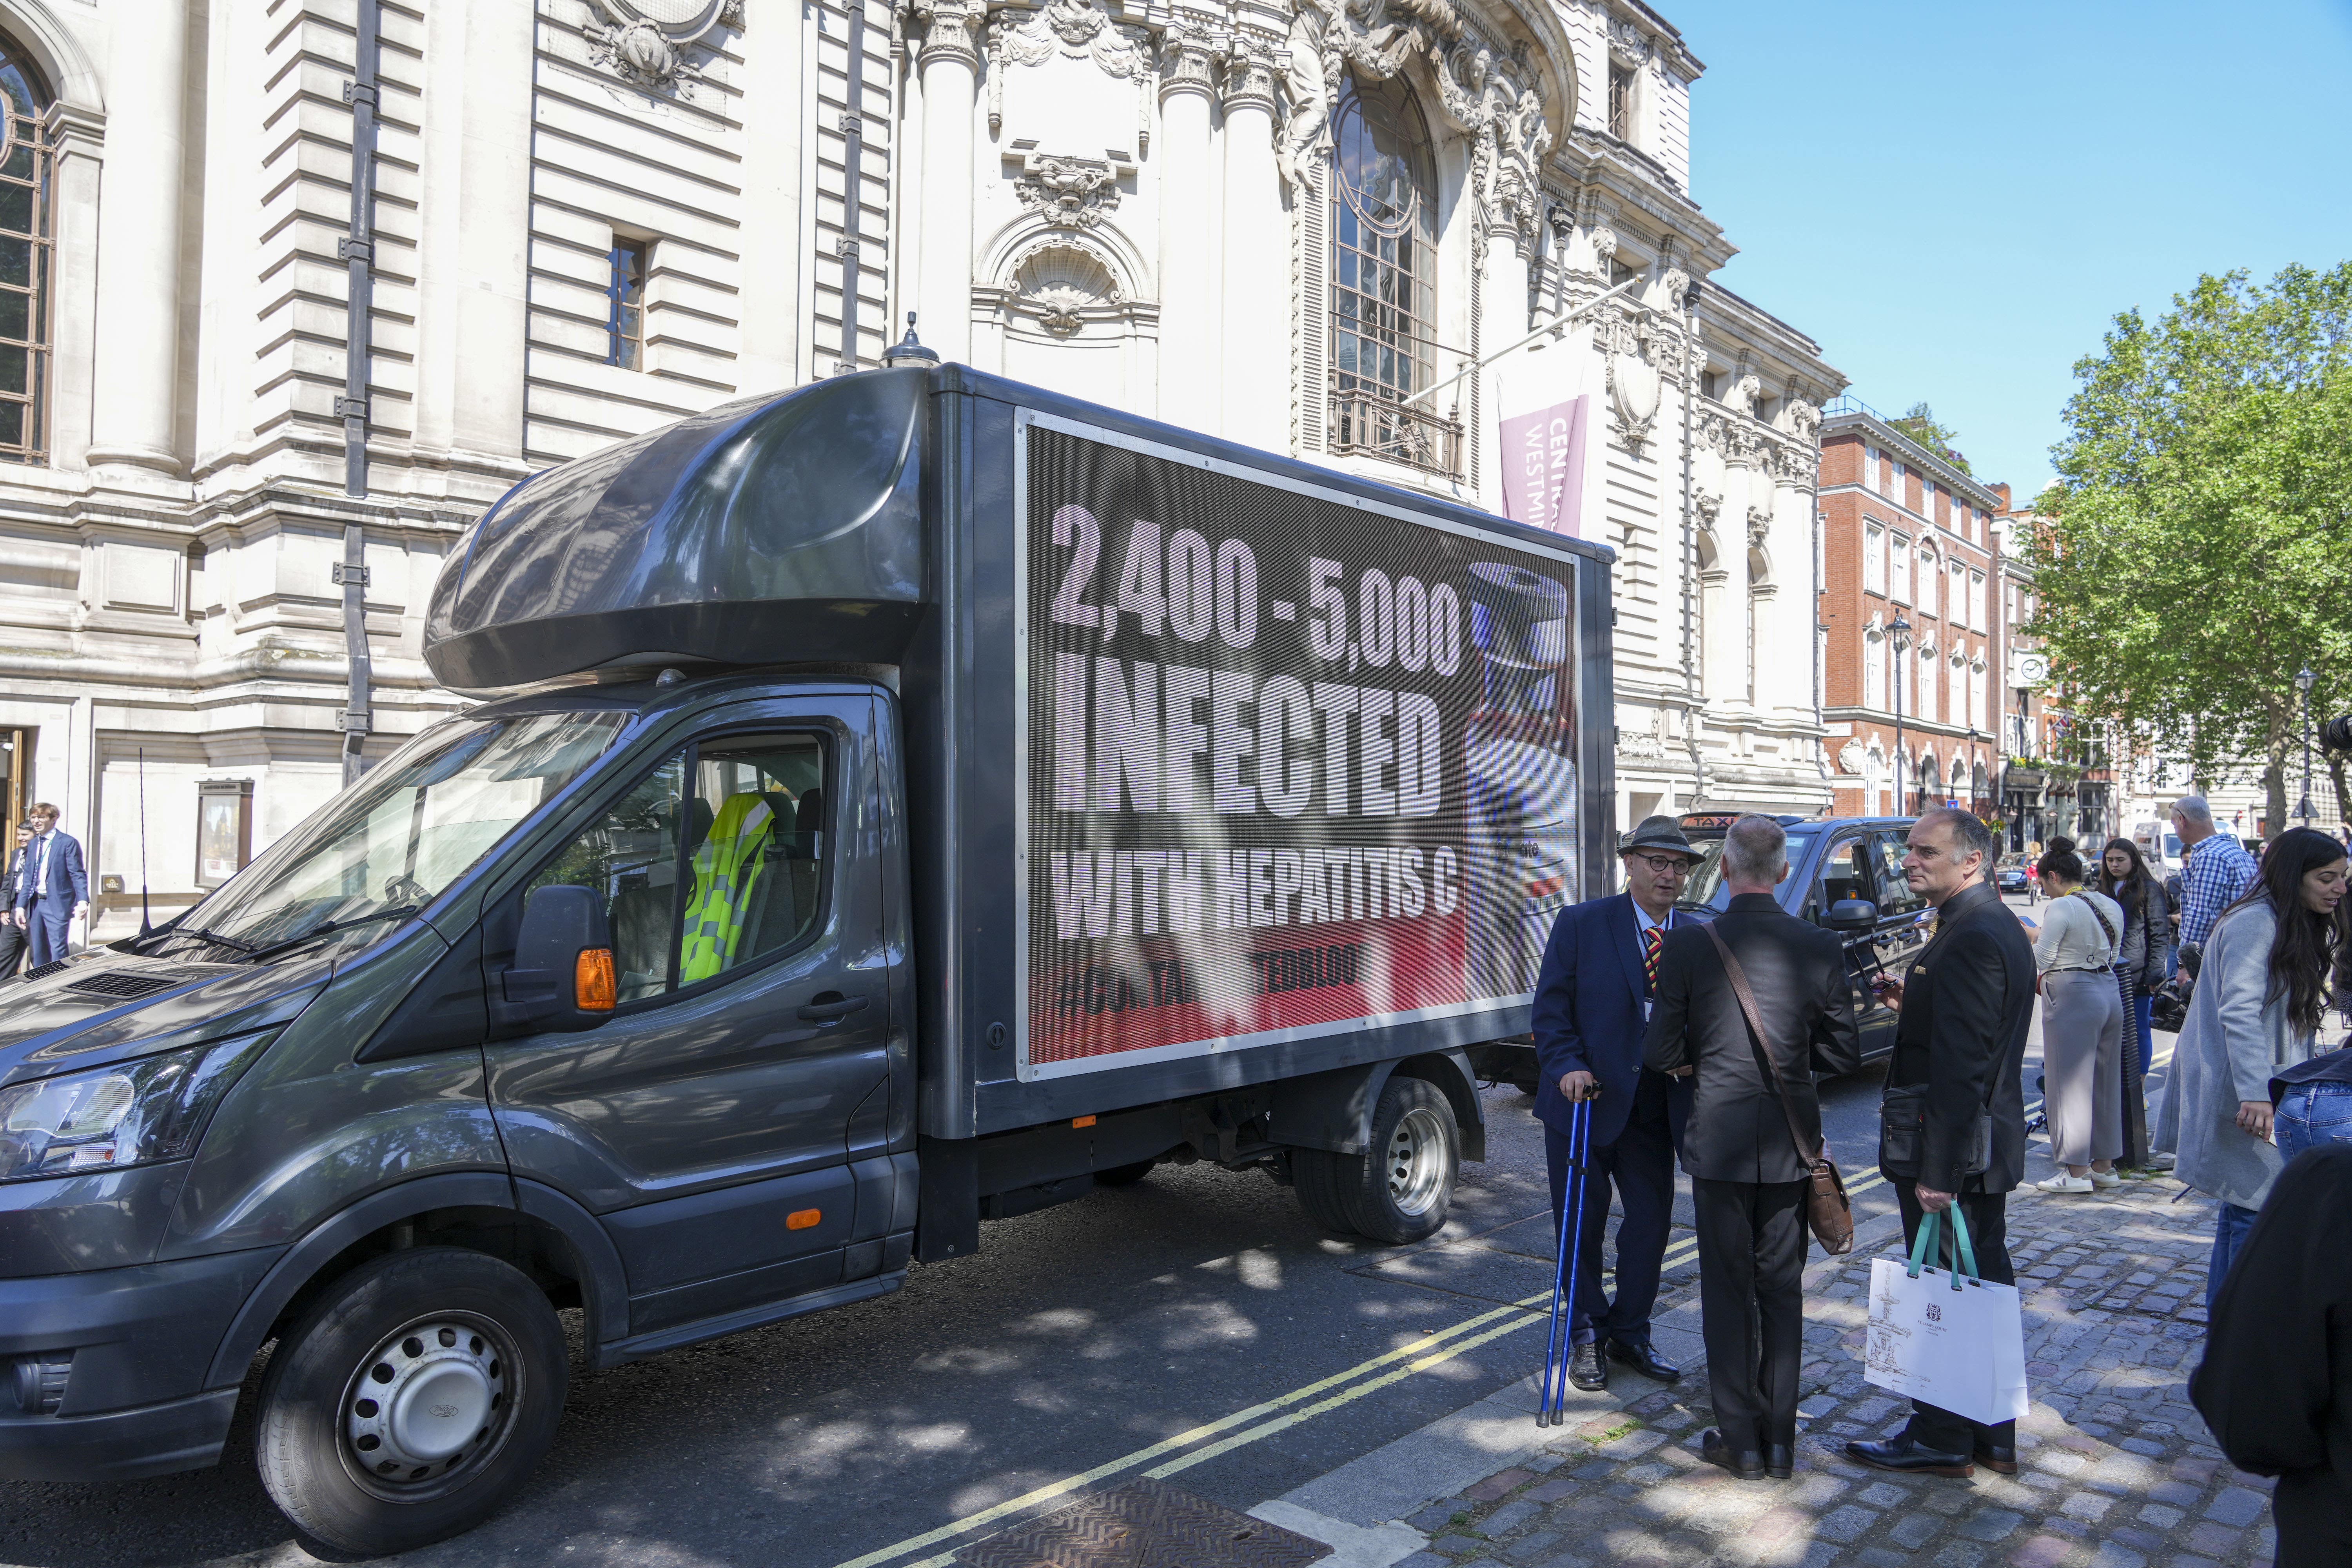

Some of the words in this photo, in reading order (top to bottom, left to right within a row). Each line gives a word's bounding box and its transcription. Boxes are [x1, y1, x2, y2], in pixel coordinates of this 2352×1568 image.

[1051, 504, 1258, 649] 2,400
[1273, 601, 1295, 621] -
[1310, 556, 1460, 676] 5,000
[1055, 652, 1441, 818] INFECTED
[1694, 818, 1734, 826] TAXI
[1051, 850, 1201, 940] WITH
[1216, 845, 1425, 929] HEPATITIS
[1434, 845, 1457, 915] C
[1056, 943, 1371, 1018] #CONTATEDBLOOD
[433, 1406, 454, 1416] Ford
